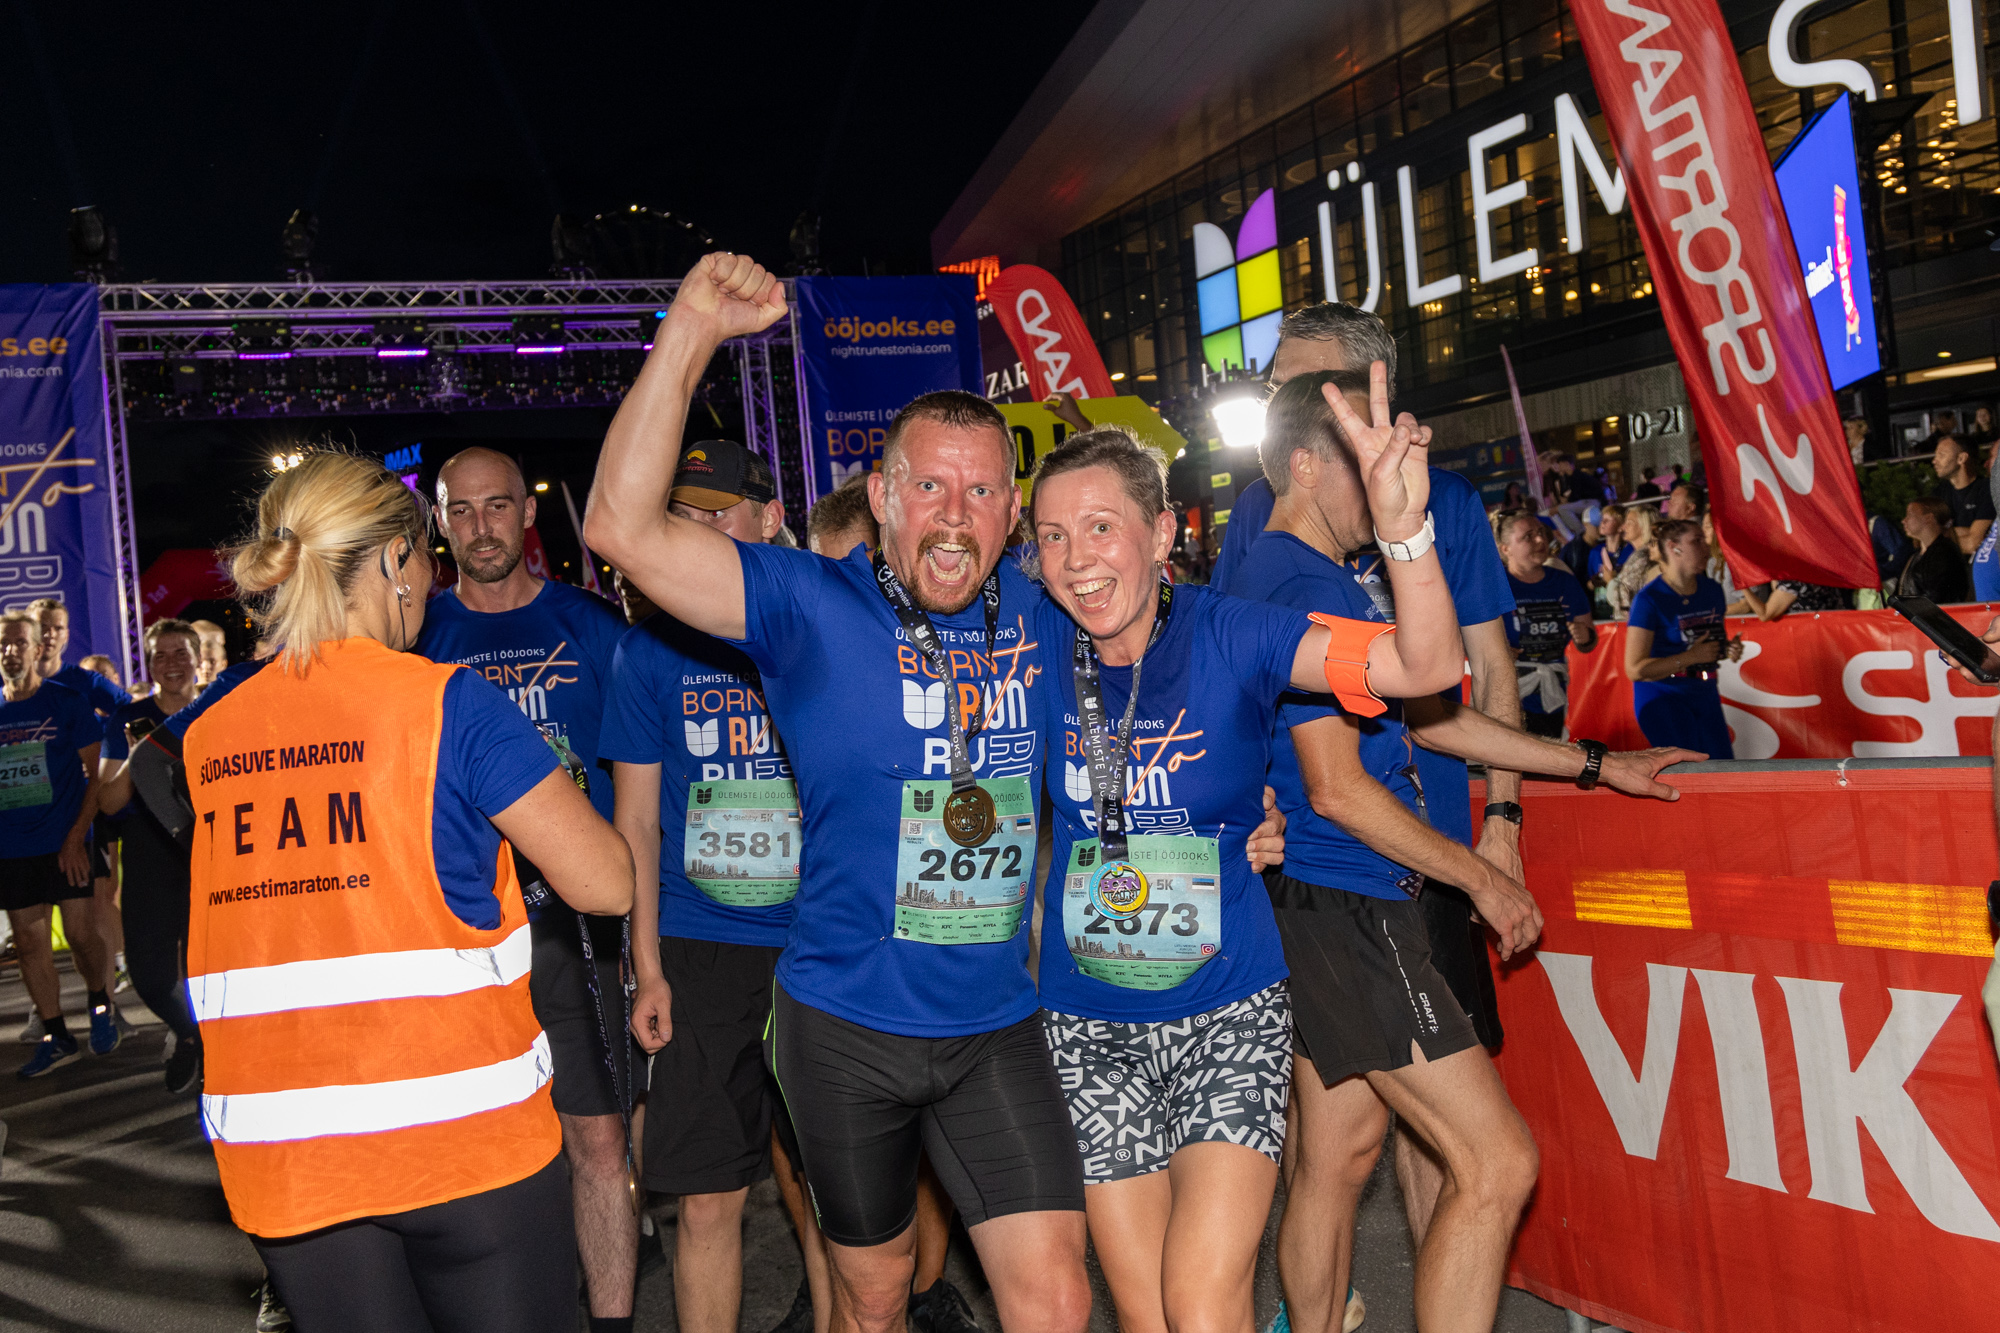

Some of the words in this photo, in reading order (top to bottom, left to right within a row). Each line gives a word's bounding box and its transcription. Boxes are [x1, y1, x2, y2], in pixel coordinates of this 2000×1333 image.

[824, 316, 956, 343] ööjooks.ee
[831, 344, 952, 359] nightrunestonia.com
[1628, 404, 1684, 443] 10-21
[1162, 585, 1172, 603] 5K
[1529, 621, 1559, 635] 852
[500, 648, 546, 659] ÖÖJOOKS
[683, 674, 734, 685] ÜLEMISTE
[957, 679, 1028, 730] RUN
[1088, 712, 1106, 770] ÜLEMISTE
[0, 763, 41, 780] 2766
[200, 748, 275, 786] SÜDASUVE
[279, 740, 365, 770] MARATON
[718, 791, 757, 799] ÜLEMISTE
[760, 813, 774, 822] 5K
[698, 831, 790, 858] 3581
[918, 844, 1023, 882] 2672
[1161, 850, 1210, 861] ÖÖJOOKS
[1156, 878, 1174, 891] 5K
[1083, 902, 1200, 937] 2673
[1418, 992, 1438, 1025] CRAFT
